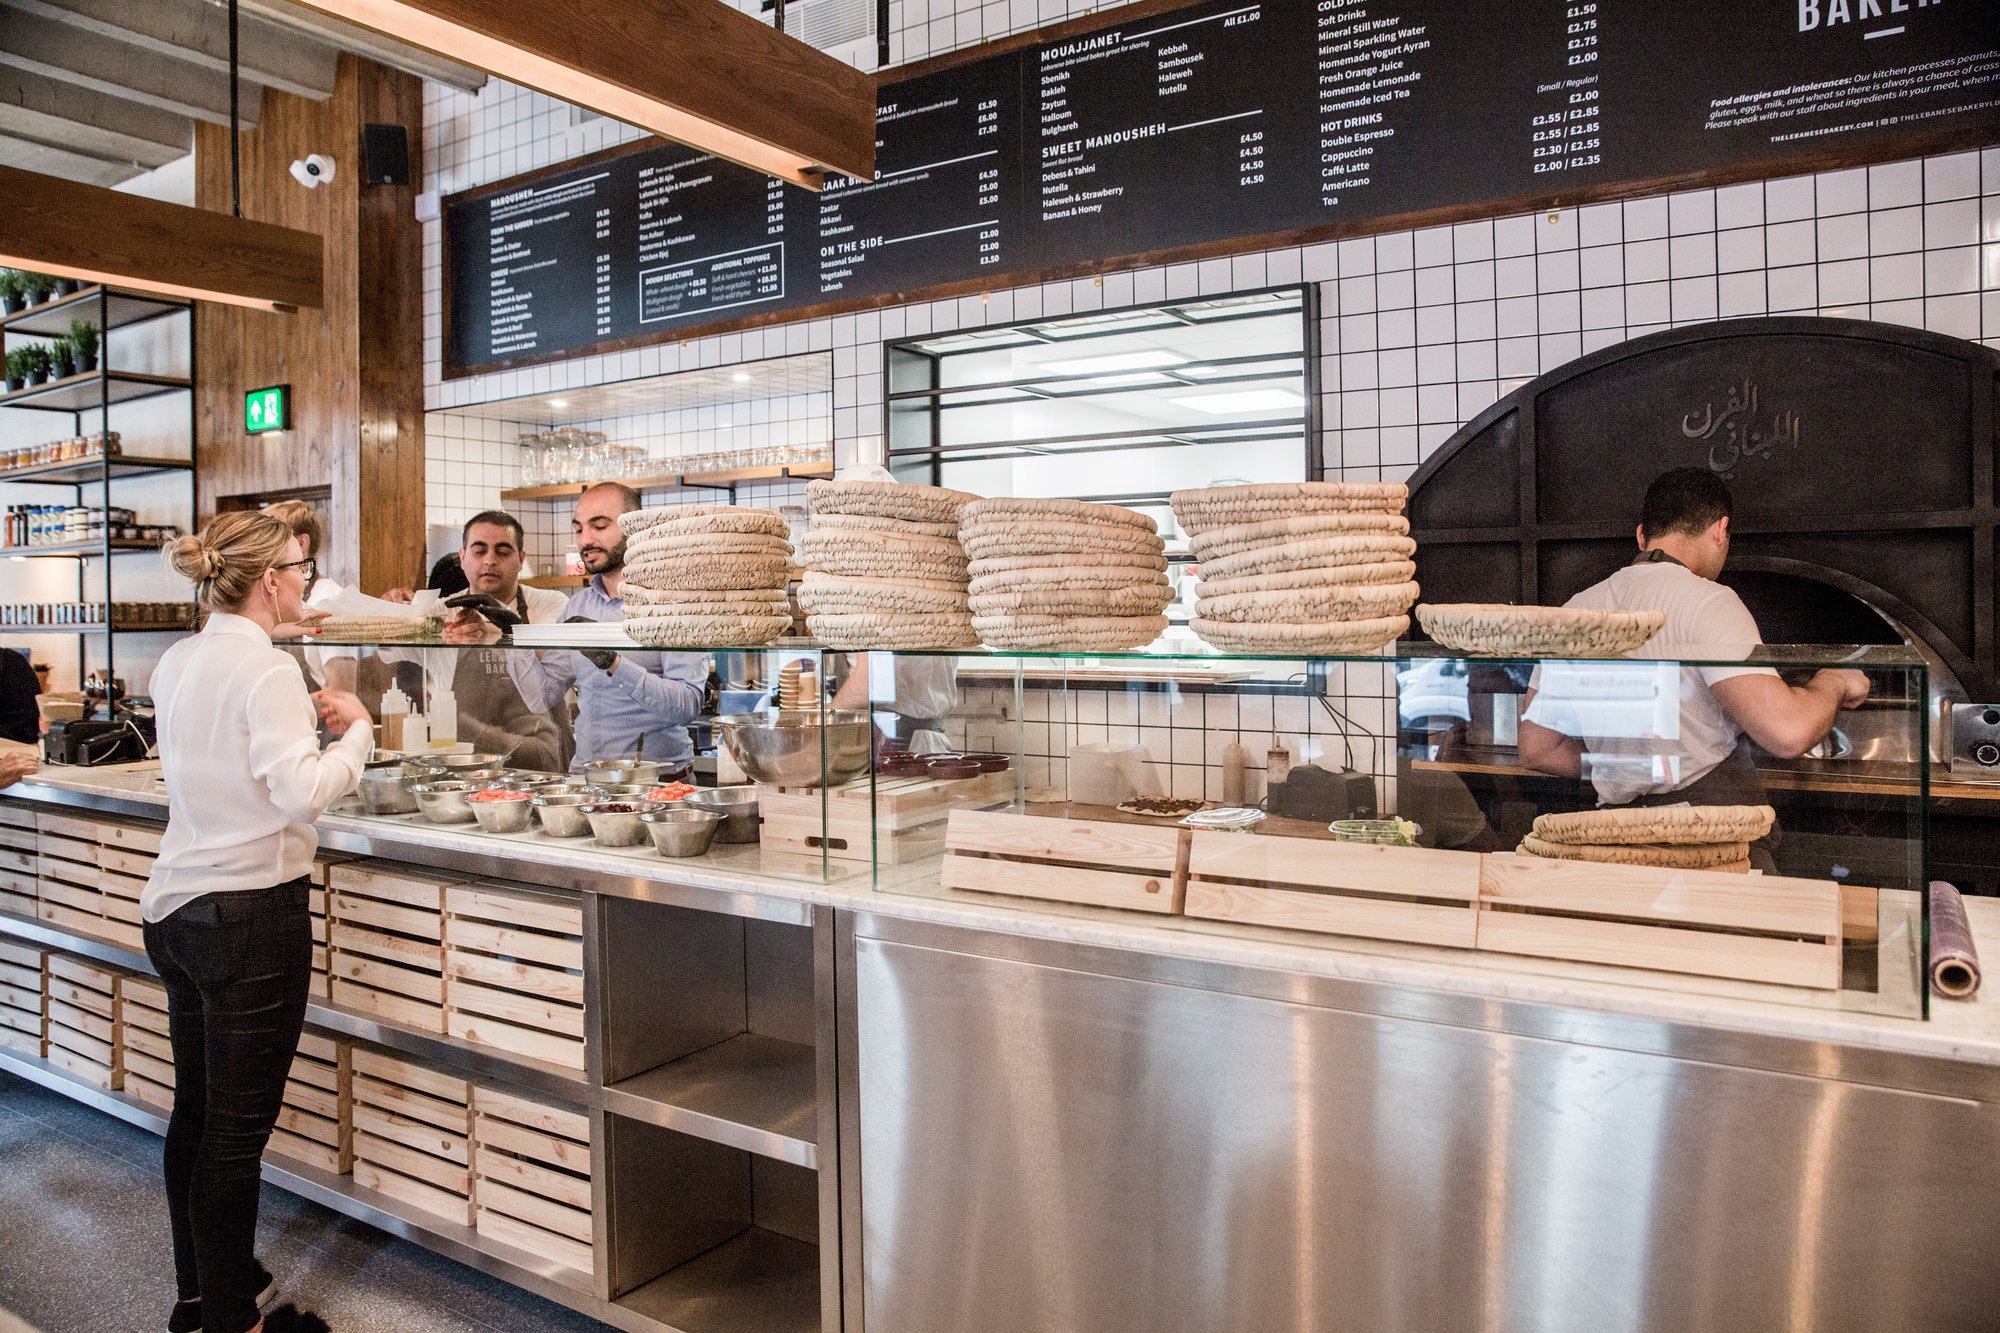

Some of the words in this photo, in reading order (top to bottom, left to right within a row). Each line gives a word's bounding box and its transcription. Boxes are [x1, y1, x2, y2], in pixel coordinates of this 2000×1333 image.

[1317, 0, 1345, 12] COLD
[1567, 4, 1596, 17] £1.50
[1224, 17, 1235, 27] All
[1237, 12, 1260, 24] £1.00
[1318, 15, 1335, 27] Soft
[1338, 10, 1366, 22] Drinks
[1319, 26, 1351, 41] Mineral
[1353, 22, 1370, 33] Still
[1372, 17, 1399, 29] Water
[1568, 20, 1596, 33] £2.75
[1041, 32, 1121, 61] MOUAJJANET
[1319, 41, 1351, 55] Mineral
[1353, 33, 1396, 48] Sparkling
[1398, 26, 1425, 38] Water
[1568, 36, 1597, 49] £2.75
[1159, 43, 1187, 56] Kebbeh
[1319, 52, 1370, 70] Homemade
[1372, 46, 1401, 58] Yogurt
[1403, 41, 1430, 53] Ayran
[1159, 53, 1203, 69] Sambousek
[1568, 52, 1597, 65] £2.00
[1041, 71, 1070, 84] Sbenikh
[1159, 68, 1192, 82] Haleweh
[1320, 72, 1343, 84] Fresh
[1345, 67, 1377, 79] Orange
[1379, 61, 1403, 72] Juice
[1159, 83, 1187, 95] Nutella
[1320, 82, 1371, 98] Homemade
[1373, 72, 1420, 88] Lemonade
[1537, 82, 1560, 94] (Small
[1566, 75, 1598, 87] Regular)
[1711, 97, 1732, 107] Food
[1733, 92, 1771, 103] allergies
[1773, 87, 1791, 97] and
[1792, 78, 1852, 93] intolerances:
[1854, 74, 1871, 82] Our
[1873, 68, 1906, 79] kitchen
[1908, 59, 1955, 74] processes
[1042, 85, 1065, 97] Bakleh
[1570, 90, 1598, 103] £2.00
[1709, 109, 1738, 123] gluten,
[1740, 101, 1762, 115] eggs,
[1764, 99, 1785, 109] milk,
[1787, 95, 1804, 105] and
[1806, 91, 1833, 102] wheat
[1847, 86, 1871, 95] there
[1873, 82, 1880, 90] is
[1882, 78, 1915, 89] always
[1925, 70, 1960, 81] chance
[1962, 65, 1975, 74] of
[978, 100, 997, 113] £5.50
[1042, 99, 1066, 110] Zaytun
[1321, 96, 1371, 113] Homemade
[1373, 91, 1391, 103] Iced
[1394, 90, 1410, 98] Tea
[1705, 119, 1732, 129] Please
[1733, 112, 1758, 126] speak
[1760, 111, 1778, 120] with
[1796, 104, 1816, 115] staff
[1817, 101, 1844, 111] about
[1845, 92, 1896, 107] ingredients
[1899, 89, 1908, 97] in
[1909, 86, 1931, 97] your
[1933, 80, 1959, 91] meal,
[1963, 76, 1989, 86] when
[1042, 111, 1071, 123] Halloum
[1533, 113, 1561, 126] £2.55
[1570, 106, 1599, 119] £2.85
[1901, 100, 2000, 121] THELEBANESEBAKERYLD
[979, 112, 997, 123] £6.00
[1321, 120, 1342, 132] HOT
[1344, 113, 1382, 128] DRINKS
[979, 125, 997, 135] £7.50
[1042, 121, 1078, 136] Bulghareh
[1533, 129, 1561, 141] £2.55
[1570, 122, 1599, 135] £2.85
[1771, 121, 1873, 142] THELEBANESEBAKERY.COM
[1042, 140, 1081, 158] SWEET
[1086, 123, 1165, 149] MANOUSHEH
[1241, 132, 1263, 143] £4.50
[1321, 135, 1352, 148] Double
[1355, 129, 1394, 142] Espresso
[1240, 146, 1263, 157] £4.50
[1322, 147, 1373, 162] Cappuccino
[1534, 145, 1561, 157] £2.30
[1571, 139, 1599, 151] £2.55
[1241, 160, 1263, 171] £4.50
[1322, 165, 1344, 176] Caffé
[1347, 163, 1369, 173] Latte
[1534, 161, 1562, 173] £2.00
[1571, 155, 1600, 167] £2.35
[639, 167, 655, 178] MEAT
[979, 170, 998, 180] £4.50
[1043, 171, 1067, 181] Debess
[1068, 168, 1075, 176] &
[1074, 164, 1095, 175] Tahini
[1241, 174, 1264, 185] £4.50
[1322, 178, 1369, 191] Americano
[979, 182, 998, 192] £5.00
[1043, 183, 1068, 194] Nutella
[980, 195, 998, 205] £5.00
[1043, 195, 1076, 207] Haleweh
[1082, 187, 1123, 200] Strawberry
[1323, 198, 1338, 206] Tea
[820, 204, 840, 214] Zaatar
[1043, 210, 1072, 220] Banana
[1079, 204, 1102, 214] Honey
[820, 214, 841, 225] Akkawi
[820, 224, 853, 237] Kashkawan
[980, 229, 999, 239] £3.00
[821, 246, 834, 257] ON
[838, 242, 856, 253] THE
[860, 236, 883, 249] SIDE
[980, 242, 999, 252] £3.00
[710, 258, 744, 273] ADDITIONAL
[744, 253, 772, 266] TOPPINGS
[821, 257, 849, 268] Seasonal
[848, 254, 864, 264] Salad
[980, 255, 999, 264] £3.50
[821, 269, 852, 283] Vegetables
[821, 282, 842, 292] Labneh
[486, 664, 505, 674] BAK
